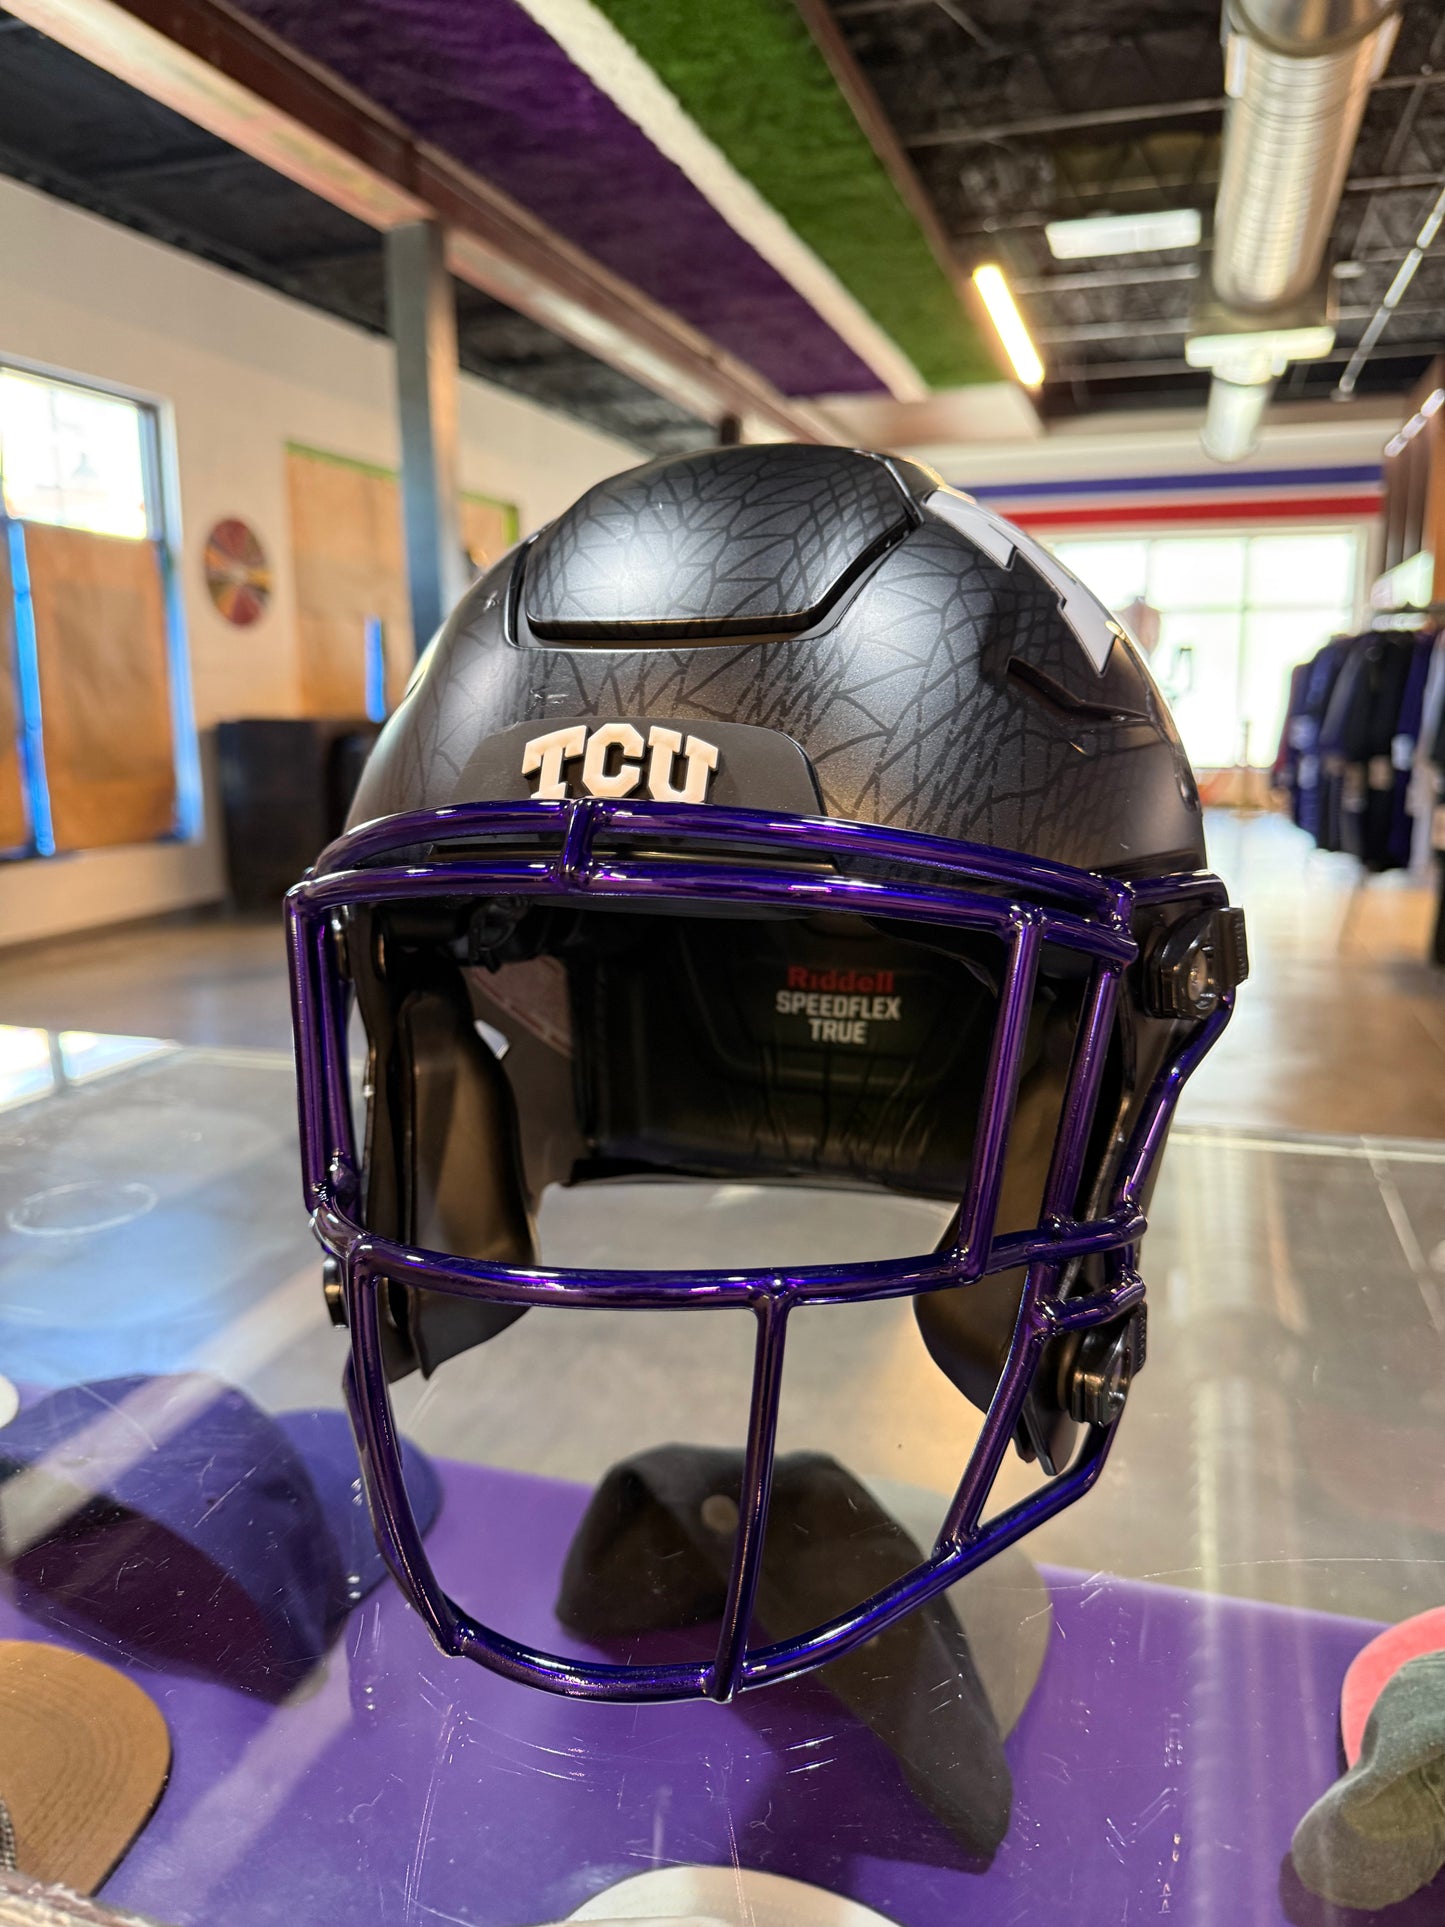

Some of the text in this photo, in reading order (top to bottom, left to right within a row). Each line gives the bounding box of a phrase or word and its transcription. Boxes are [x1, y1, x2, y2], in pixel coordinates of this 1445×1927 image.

[522, 723, 718, 804] TCU
[787, 966, 894, 993] Riddell
[775, 990, 901, 1020] SPEEDFLEX
[809, 1018, 868, 1044] TRUE
